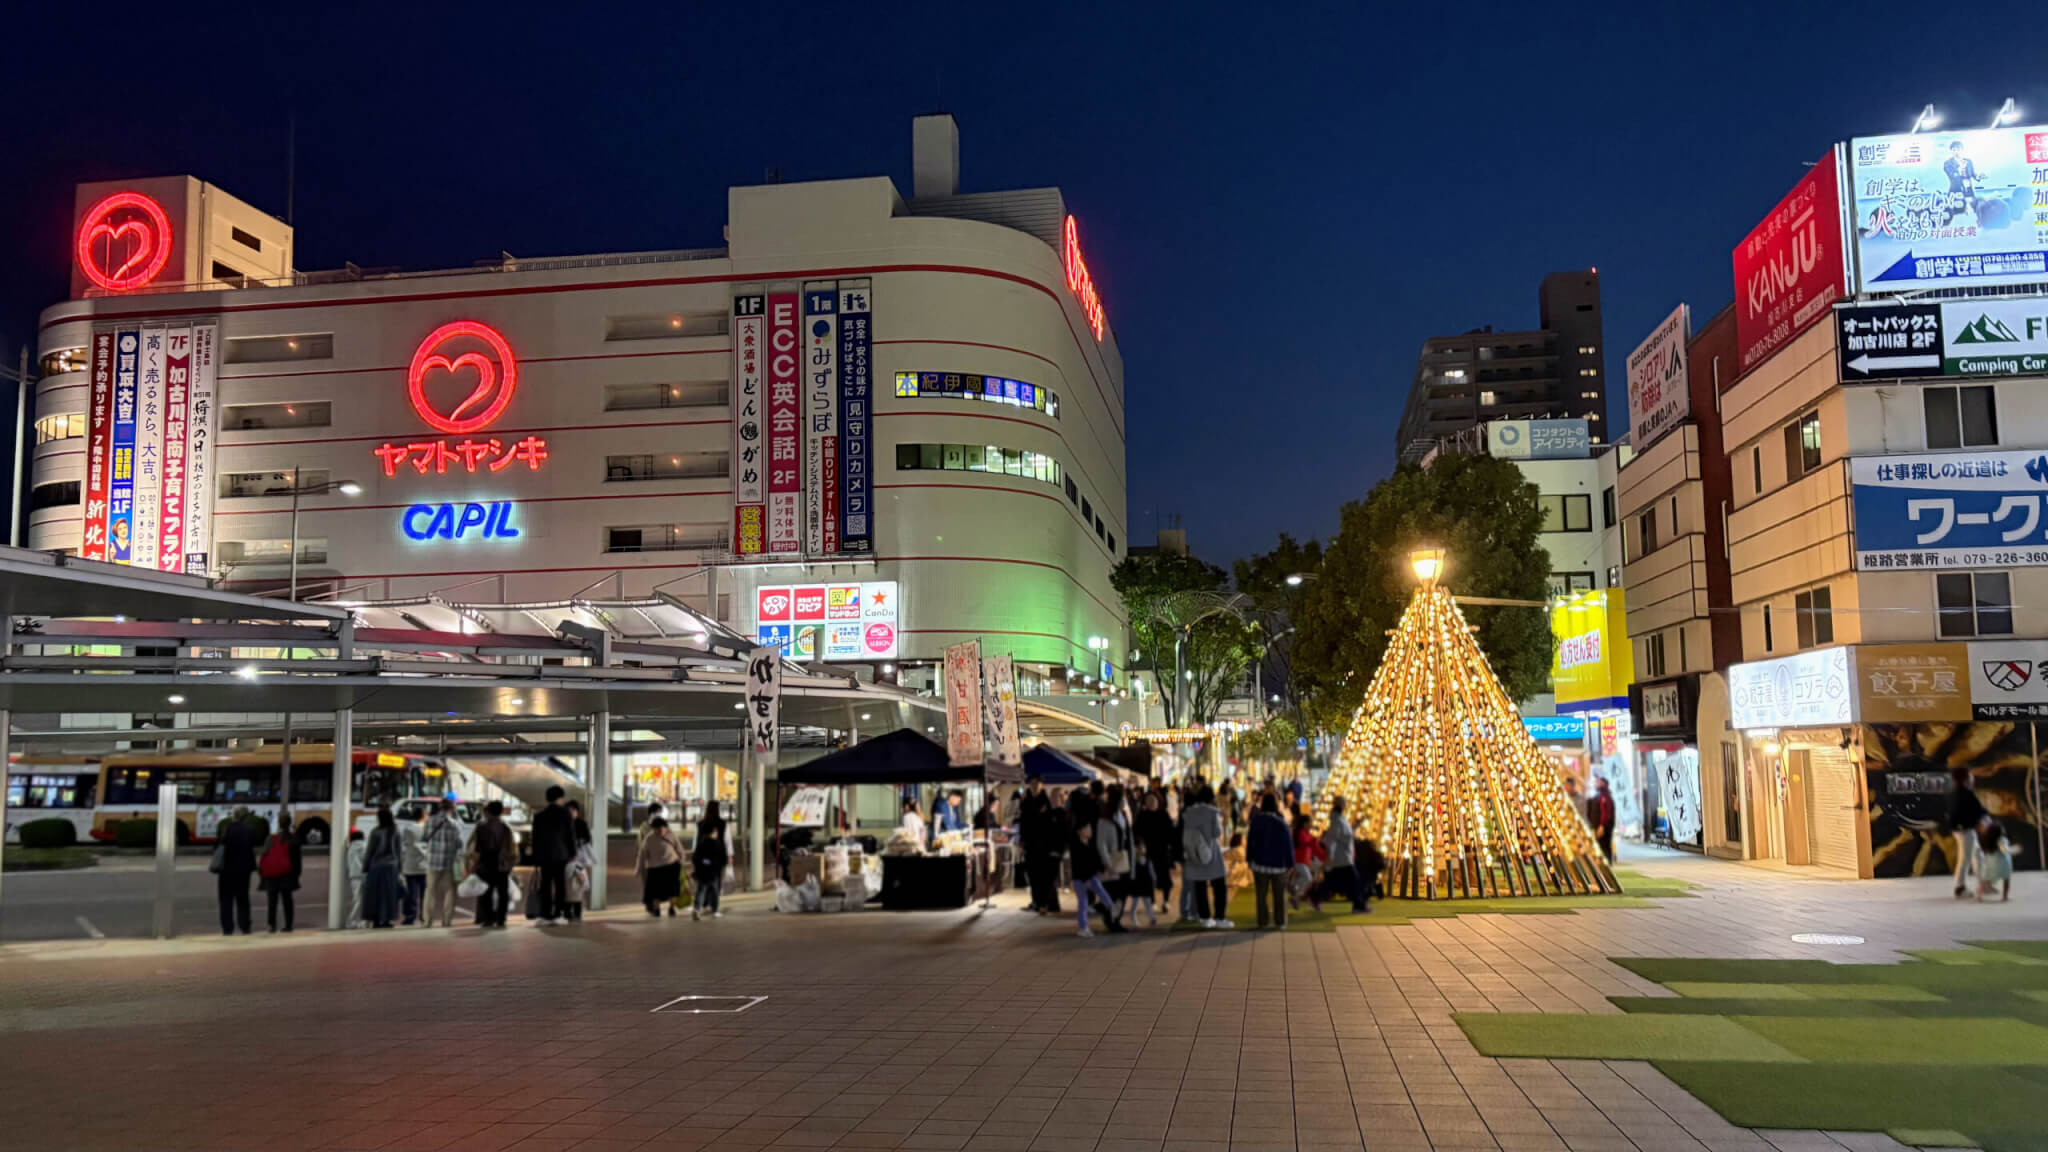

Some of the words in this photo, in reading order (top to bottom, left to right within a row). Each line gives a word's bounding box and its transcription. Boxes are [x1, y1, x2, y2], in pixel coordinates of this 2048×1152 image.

[739, 297, 761, 314] 1F
[1843, 314, 1938, 333] オートバックス
[169, 335, 188, 350] 7F
[1847, 332, 1908, 350] 加古川店
[1912, 332, 1936, 348] 2F
[1640, 346, 1666, 389] シロアリ
[1958, 358, 2018, 373] Camping
[2022, 356, 2047, 370] Car
[772, 303, 796, 460] ECC英会話
[896, 373, 918, 396] 本
[1532, 427, 1586, 438] コンタクトの
[1532, 438, 1585, 449] アイシティ
[374, 436, 548, 477] ヤマトヤシキ
[848, 402, 863, 508] 見守りカメラ
[160, 366, 187, 571] 加古川駅南子育てプラザ
[772, 470, 796, 484] 2F
[1877, 460, 2009, 482] 仕事探しの近道は
[112, 500, 131, 514] 1F
[402, 500, 519, 541] CAPIL
[775, 496, 784, 539] レッスン
[1907, 495, 2048, 545] ワーク
[1864, 553, 1939, 567] 姫路営業所
[865, 608, 894, 617] CanDo
[1868, 670, 1959, 695] 餃子屋
